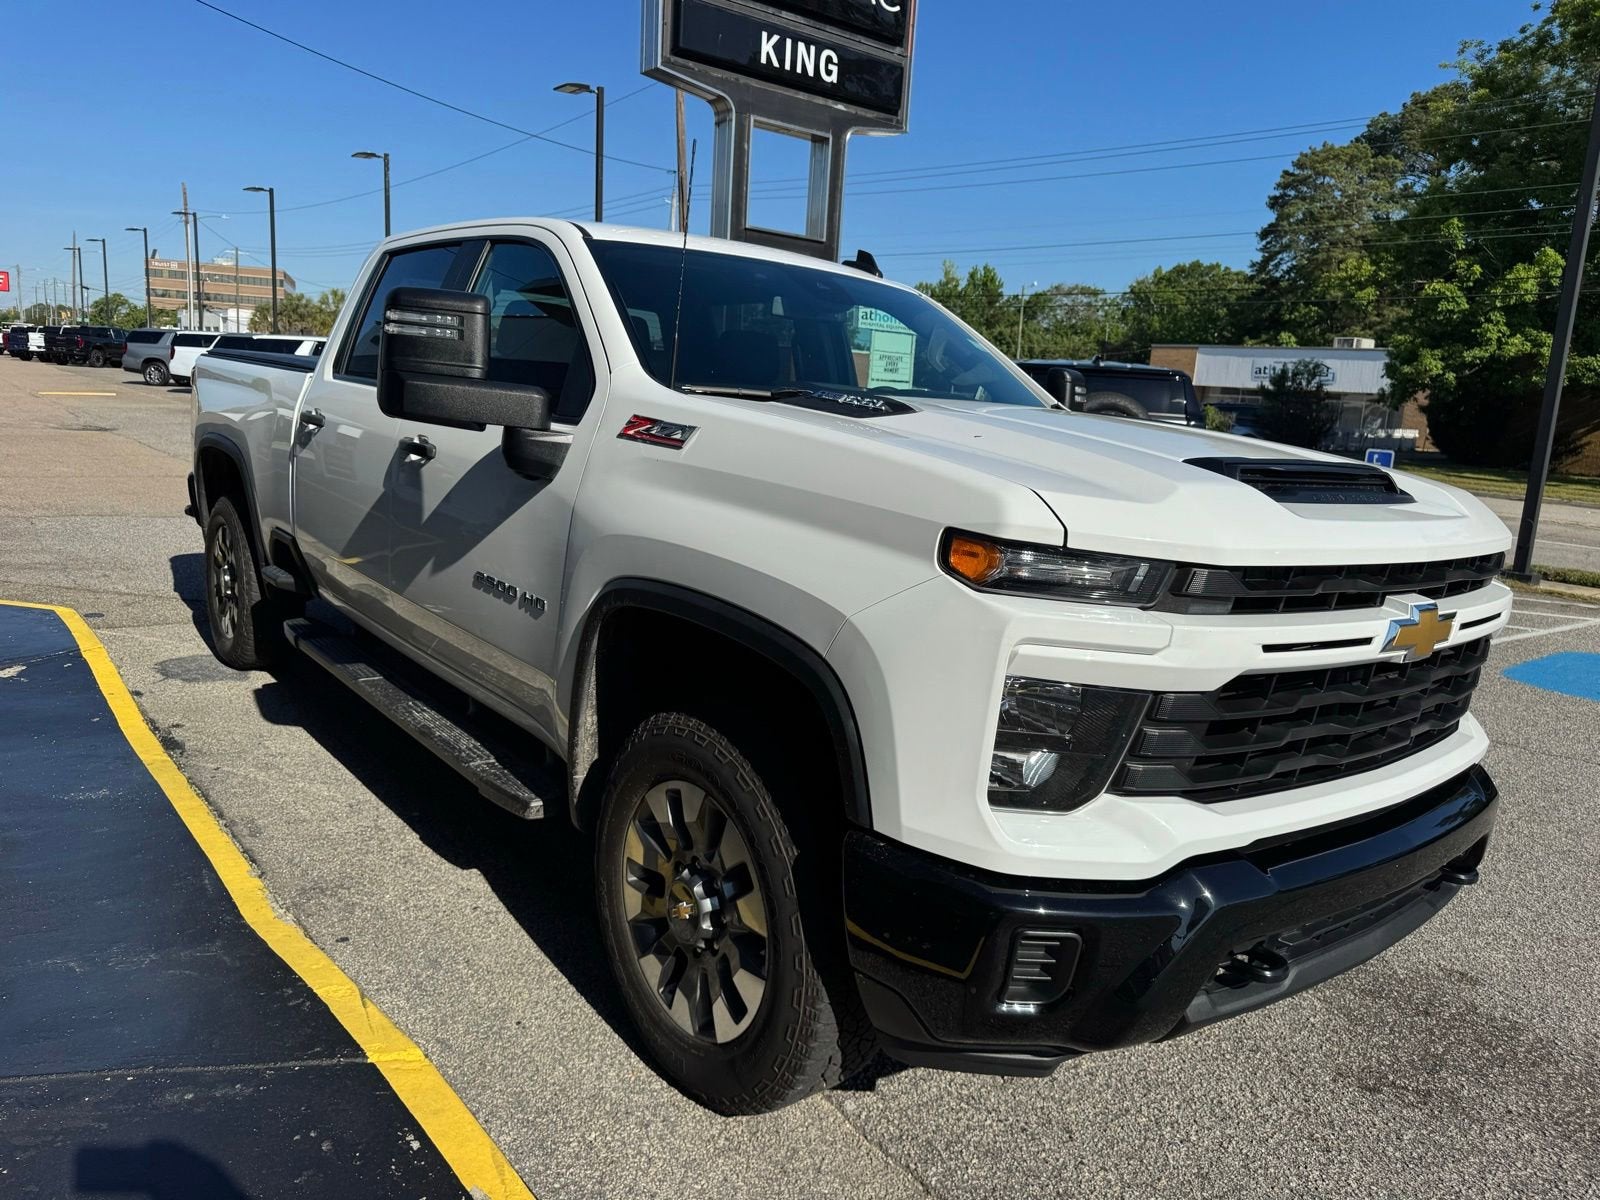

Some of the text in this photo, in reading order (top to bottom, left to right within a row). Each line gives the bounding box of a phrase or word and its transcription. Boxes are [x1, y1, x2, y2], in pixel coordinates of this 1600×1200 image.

[760, 30, 839, 84] KING
[473, 571, 547, 613] 2500 HD
